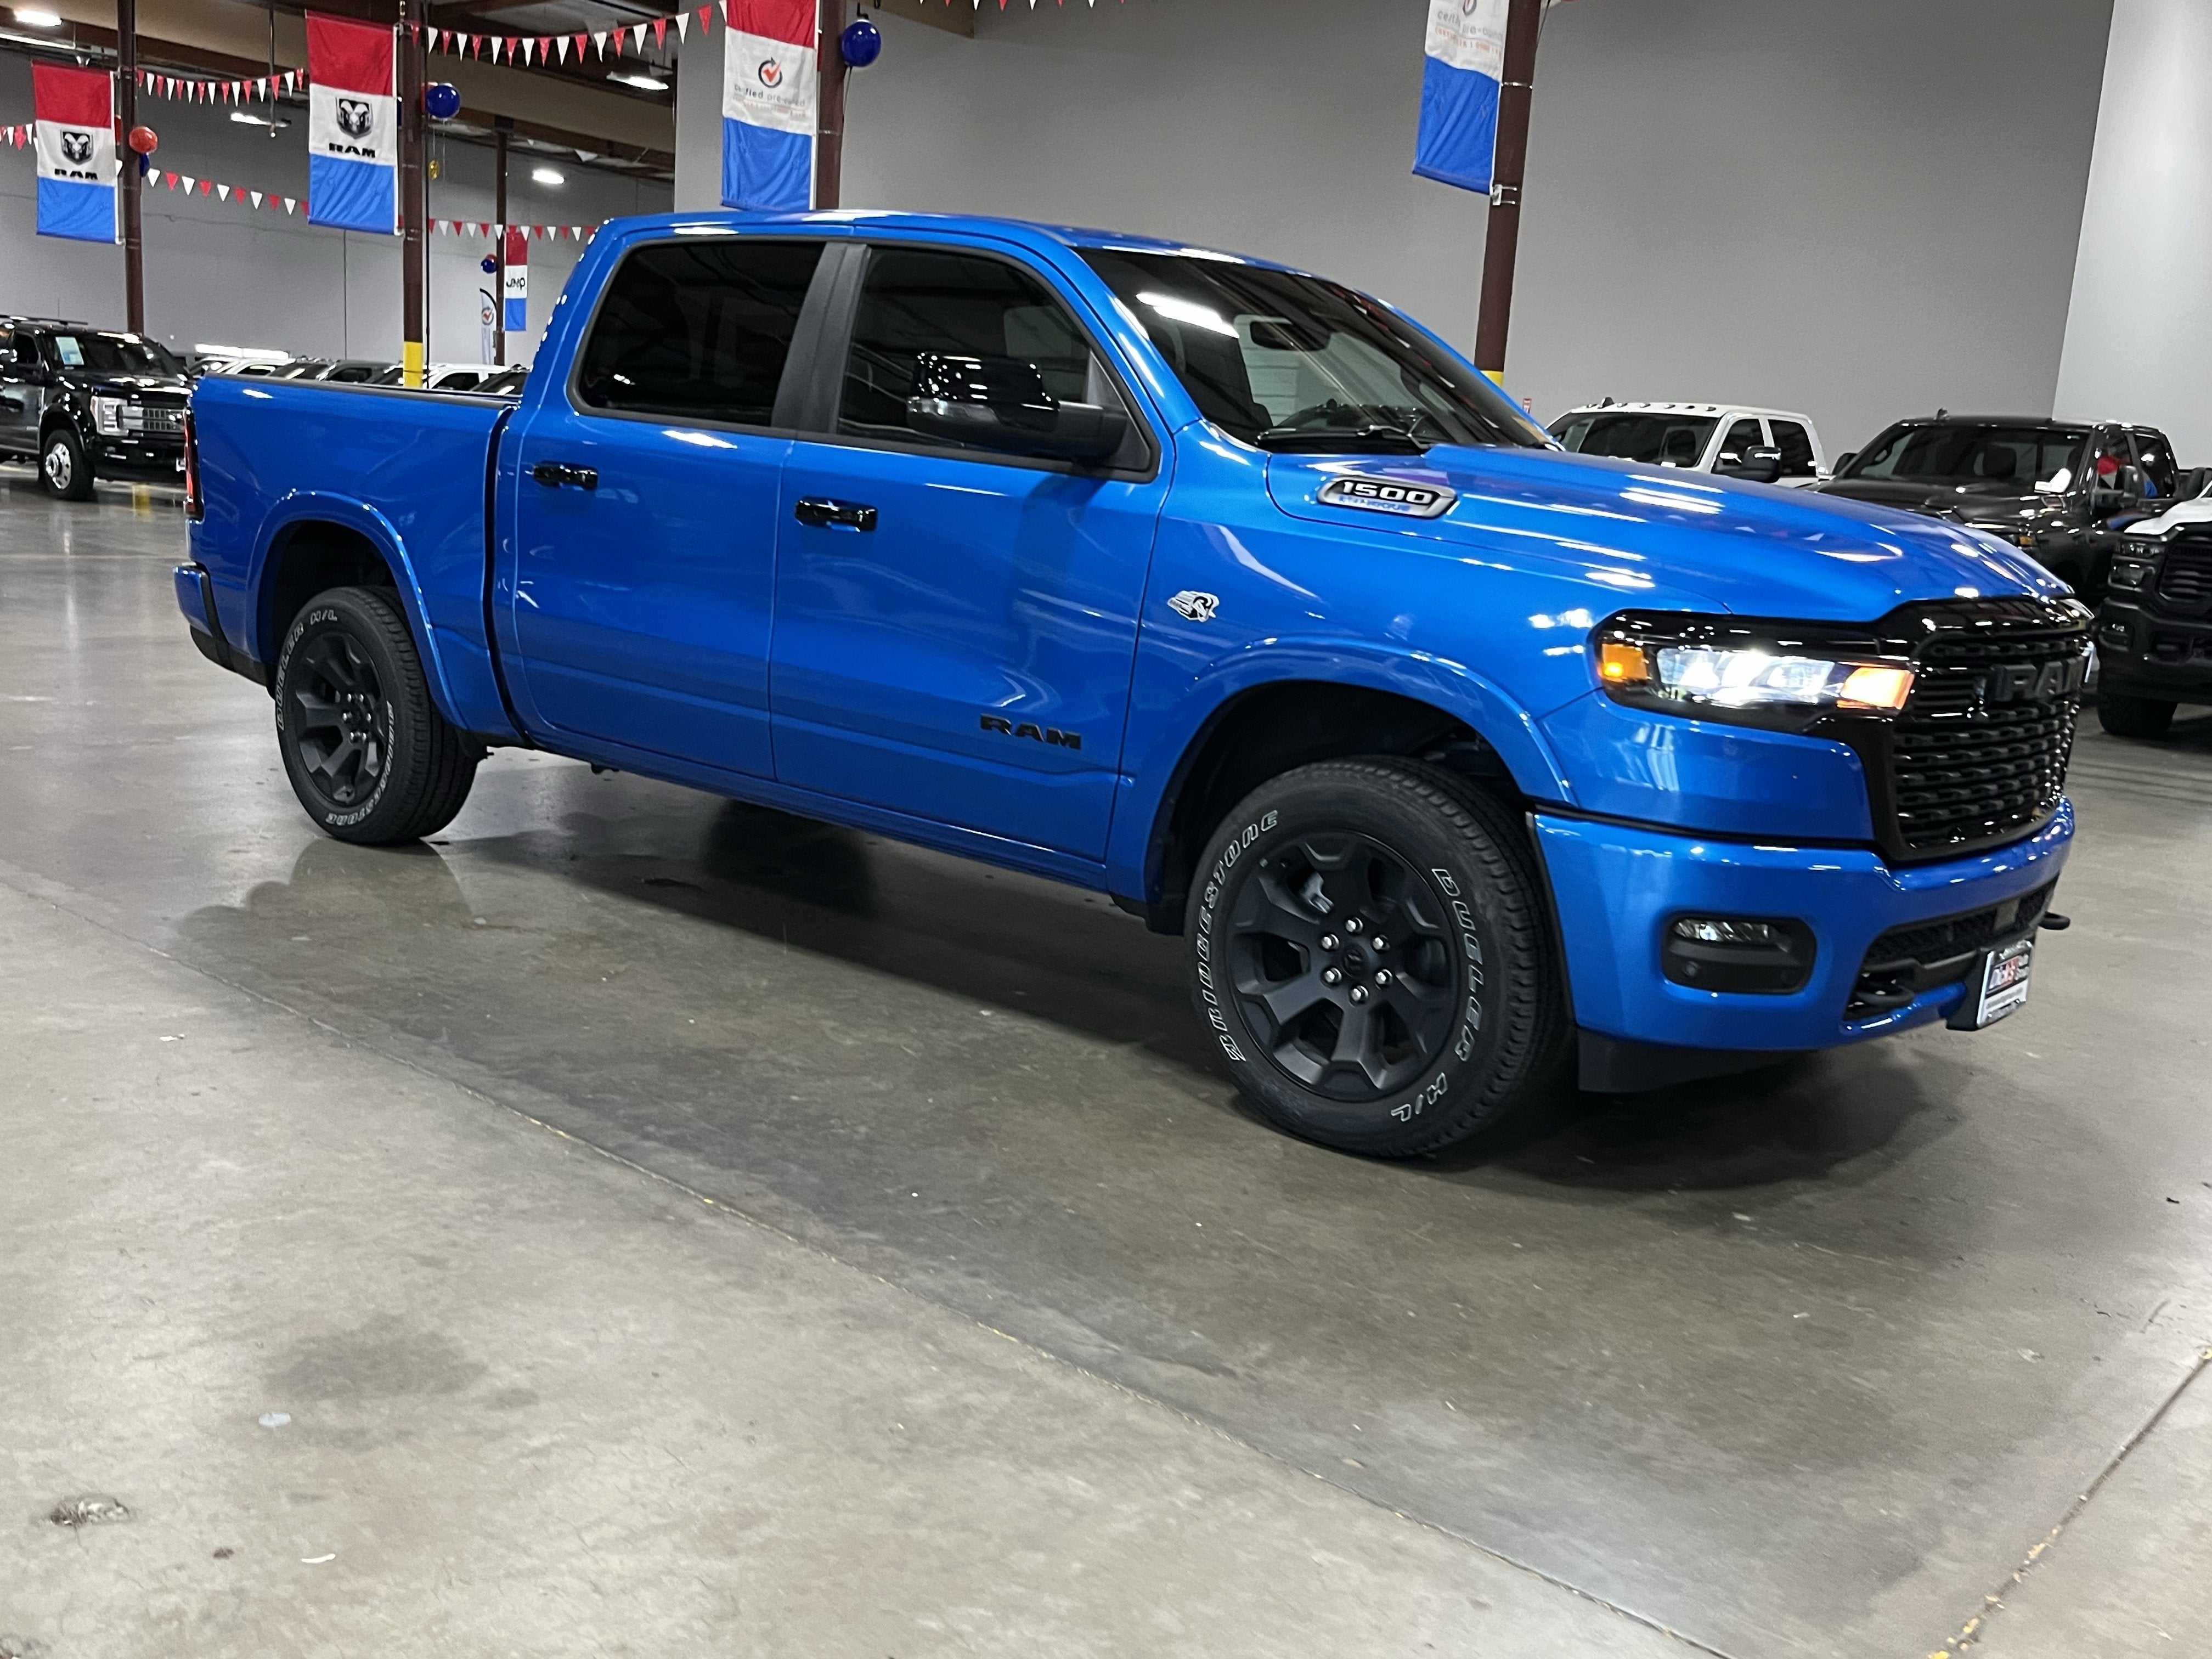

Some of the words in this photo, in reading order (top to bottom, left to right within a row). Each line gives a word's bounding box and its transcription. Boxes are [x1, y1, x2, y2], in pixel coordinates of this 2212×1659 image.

[329, 142, 375, 158] RAM
[54, 168, 98, 180] RAM
[1344, 481, 1432, 504] 1500
[980, 713, 1082, 751] RAM
[1195, 809, 1278, 1062] BRIDGESTONE
[1431, 868, 1485, 1062] DUELER
[1390, 1071, 1449, 1122] H/L
